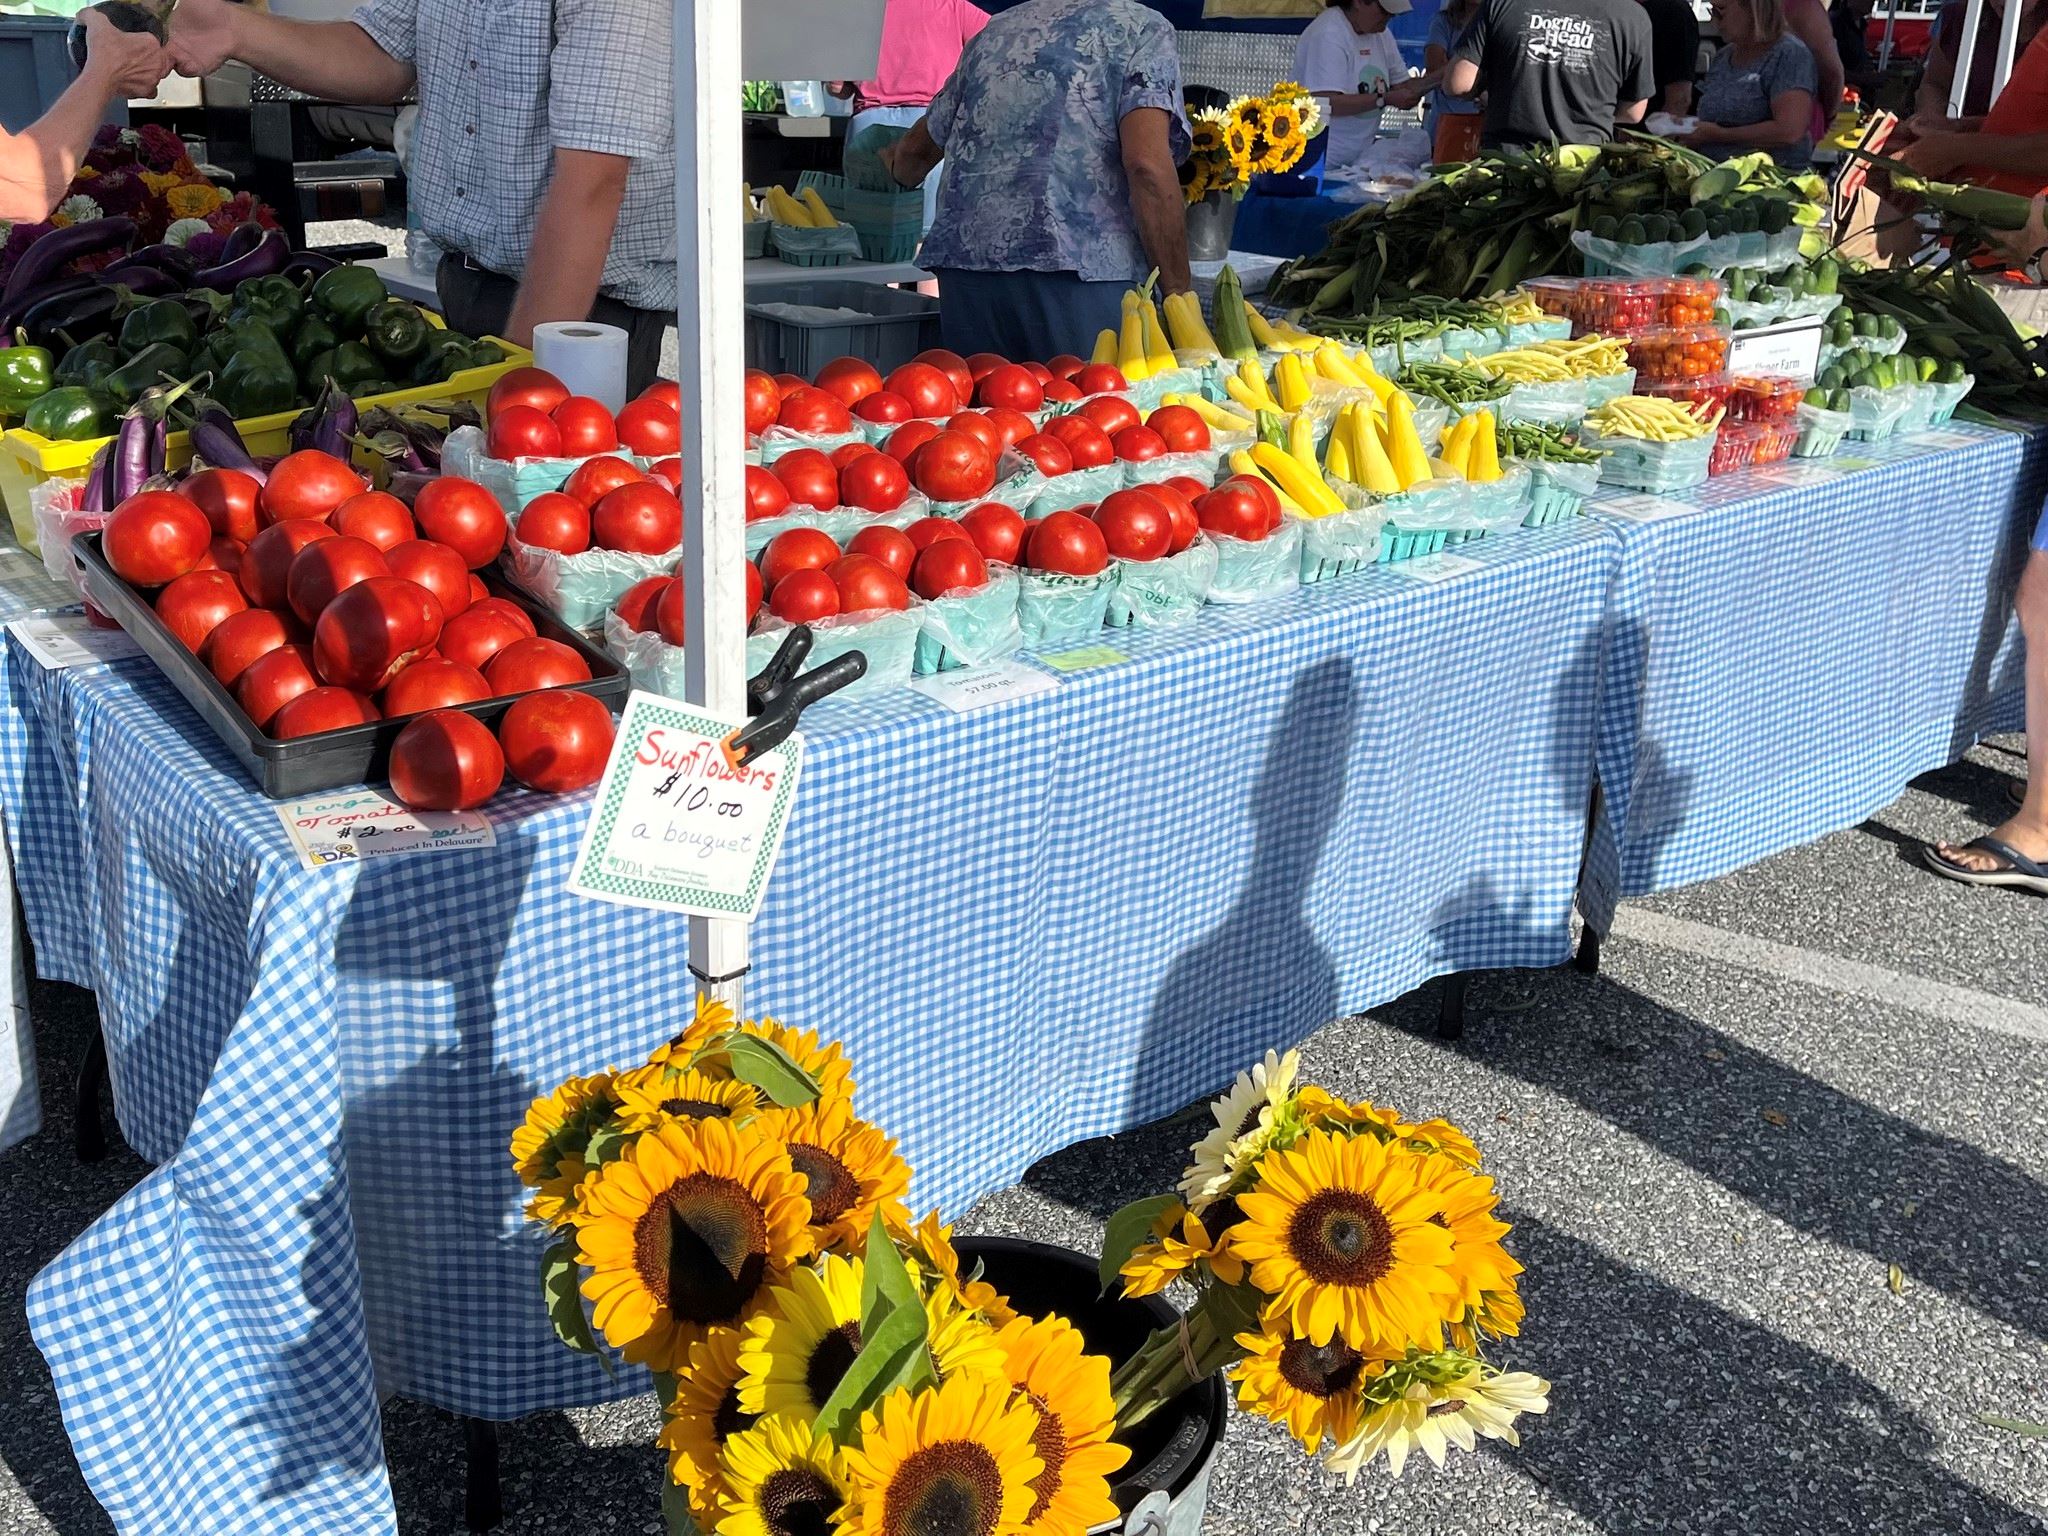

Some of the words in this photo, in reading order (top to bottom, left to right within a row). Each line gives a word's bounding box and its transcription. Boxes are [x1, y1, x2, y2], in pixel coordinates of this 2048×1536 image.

[1530, 14, 1592, 36] Dogfish
[1545, 29, 1594, 49] Head
[635, 730, 776, 791] Sunflowers
[296, 797, 384, 815] Large
[652, 772, 743, 818] $10.00
[430, 823, 486, 839] each
[631, 823, 651, 839] a
[663, 820, 752, 859] bouquet
